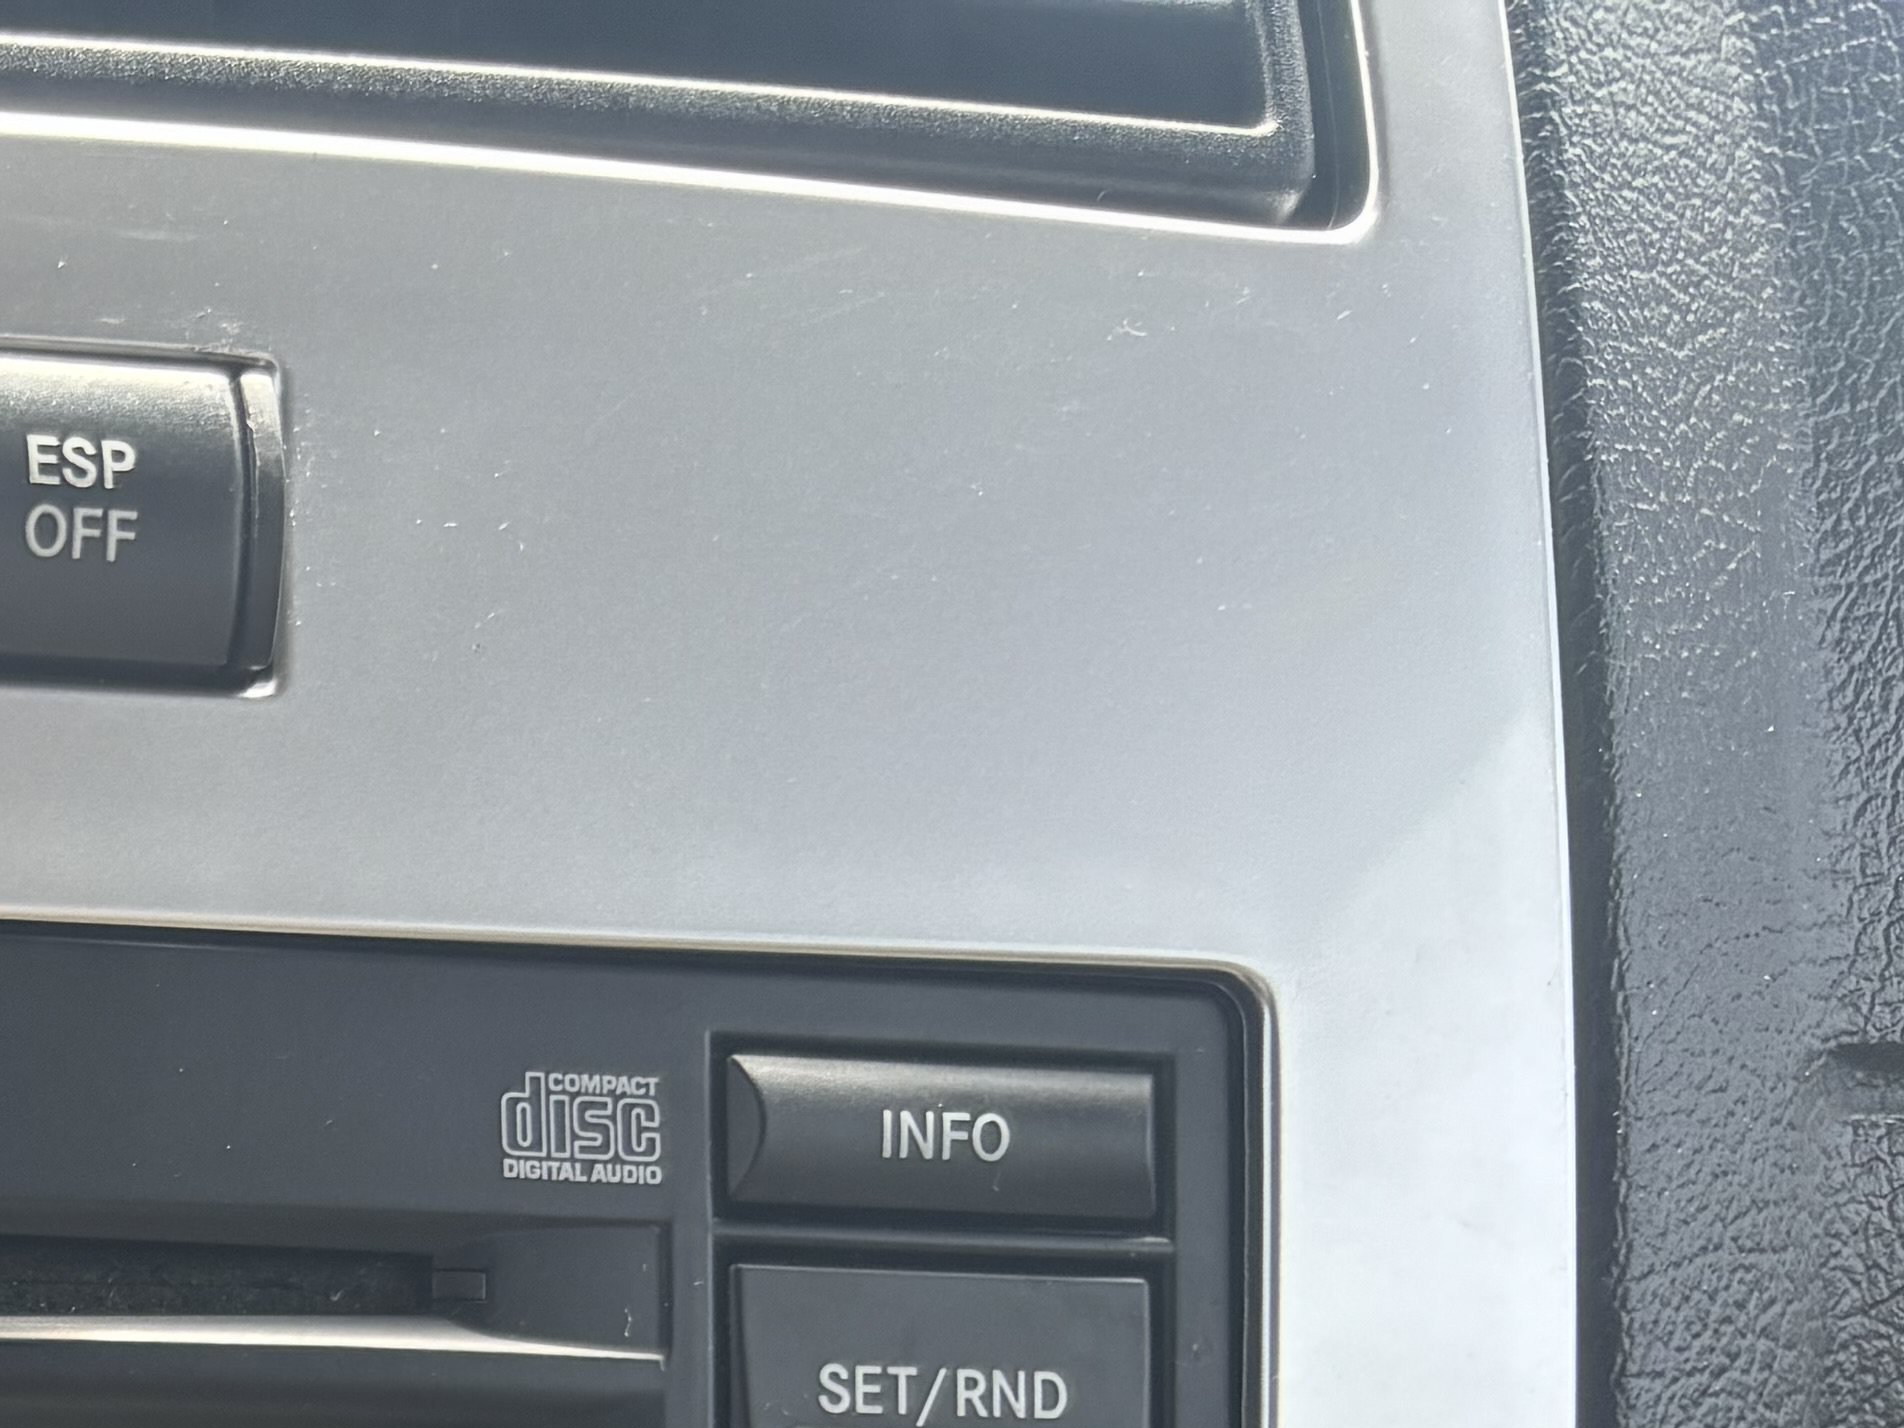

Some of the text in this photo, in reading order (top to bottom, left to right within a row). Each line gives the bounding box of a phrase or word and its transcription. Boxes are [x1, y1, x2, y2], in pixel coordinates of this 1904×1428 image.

[25, 433, 136, 490] ESP
[24, 504, 138, 563] OFF
[548, 1073, 660, 1097] COMPACT
[882, 1109, 1011, 1162] INFO
[502, 1158, 663, 1186] DIGITAL AUDIO
[818, 1363, 1069, 1427] SET/RND
